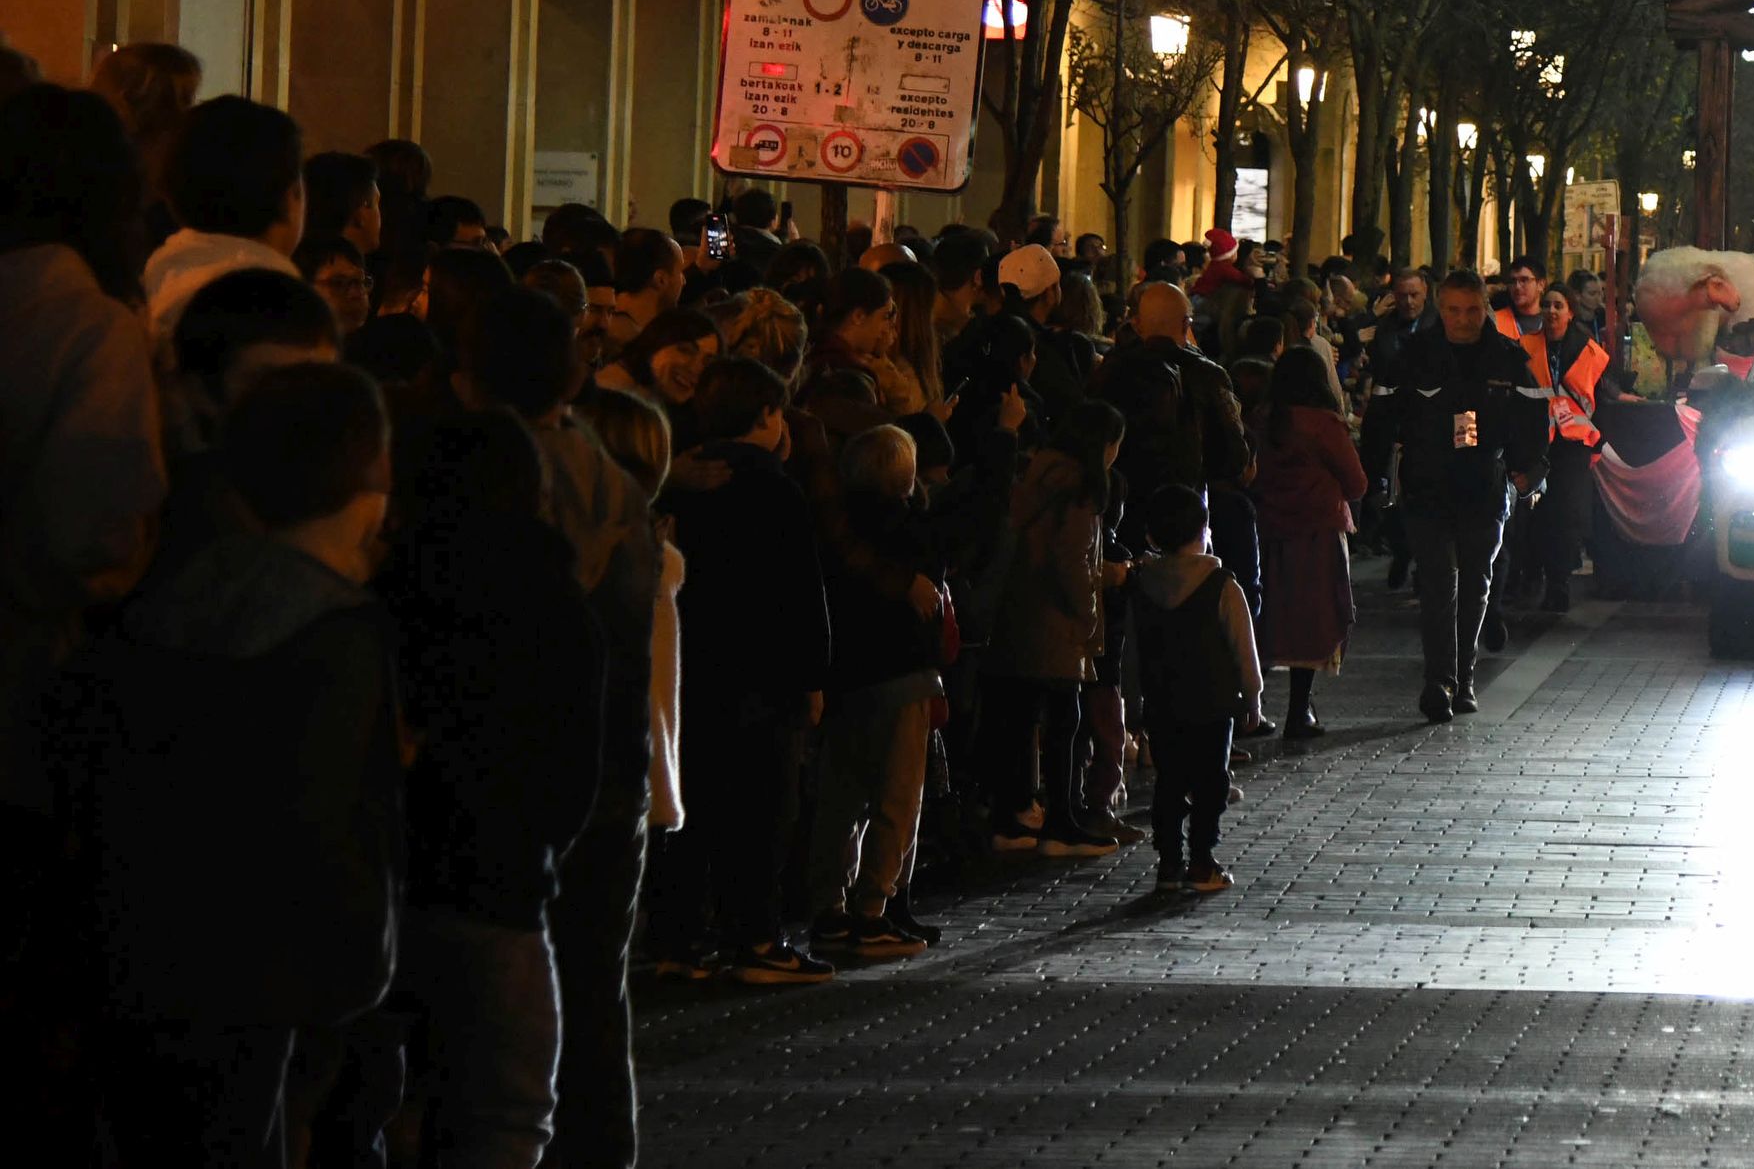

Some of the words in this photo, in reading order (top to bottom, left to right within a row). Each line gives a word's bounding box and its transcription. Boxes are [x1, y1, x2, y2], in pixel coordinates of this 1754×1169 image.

[762, 27, 770, 36] 8
[890, 26, 935, 39] excepto
[938, 30, 971, 42] carga
[749, 38, 774, 49] izan
[778, 41, 801, 51] ezik
[897, 40, 904, 49] y
[907, 39, 961, 54] descarga
[915, 53, 922, 62] 8
[740, 78, 803, 91] bertakoak
[744, 91, 769, 101] izan
[774, 93, 797, 104] ezik
[900, 93, 947, 105] excepto
[752, 104, 768, 114] 20
[781, 106, 788, 116] 8
[891, 105, 954, 118] residentes
[901, 118, 916, 128] 20
